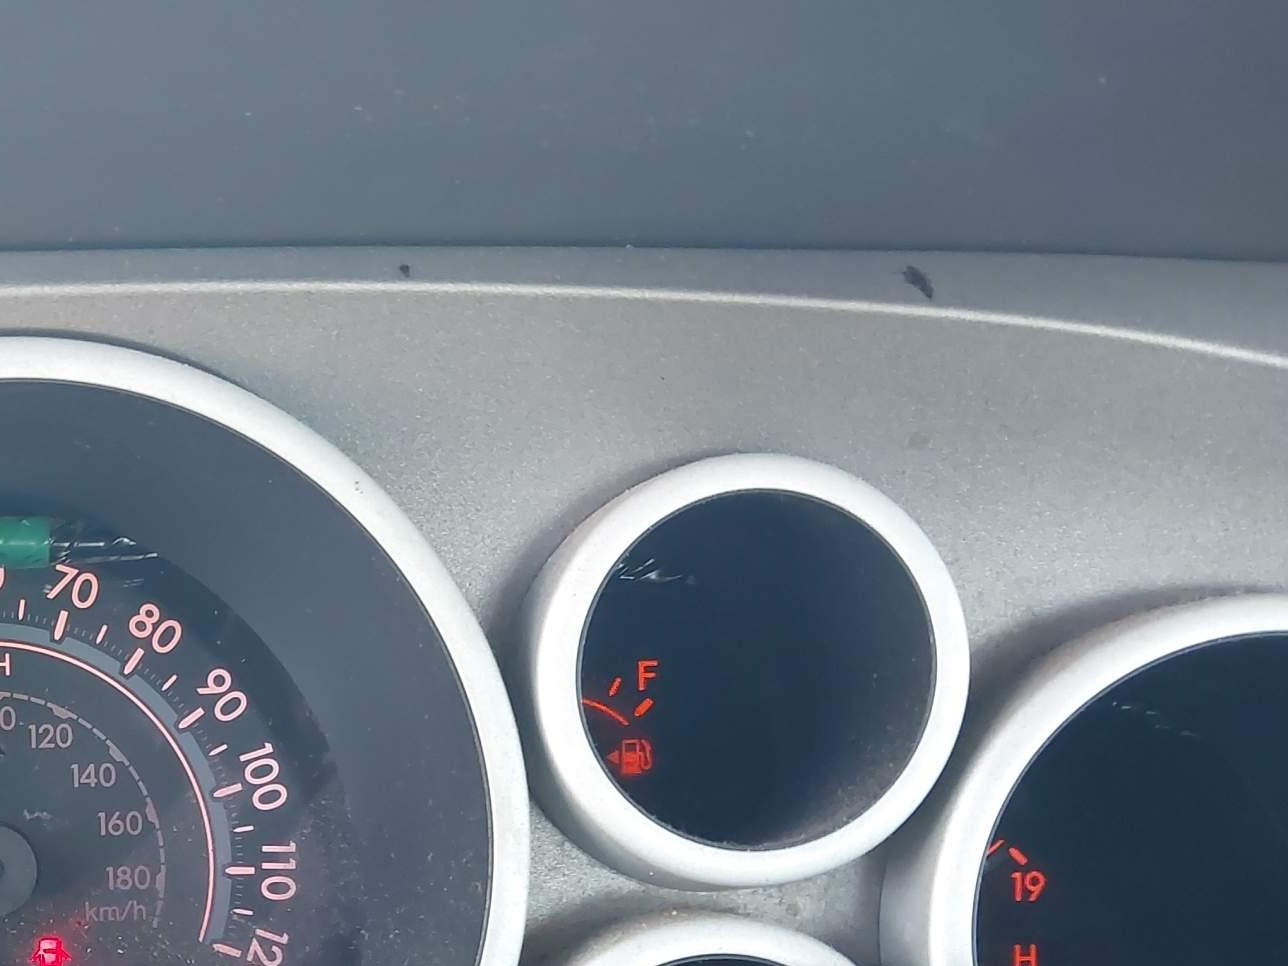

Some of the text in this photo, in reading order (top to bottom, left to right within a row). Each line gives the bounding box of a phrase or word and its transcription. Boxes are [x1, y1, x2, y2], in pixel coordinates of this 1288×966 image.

[46, 564, 99, 610] 70
[128, 602, 183, 654] 80
[638, 660, 658, 690] F
[195, 667, 248, 723] 90
[29, 723, 73, 748] 120
[70, 762, 116, 788] 140
[239, 742, 288, 811] 100
[98, 812, 143, 836] 160
[106, 866, 151, 891] 180
[260, 841, 297, 902] 110
[1011, 871, 1046, 902] 19
[85, 900, 148, 924] km/h
